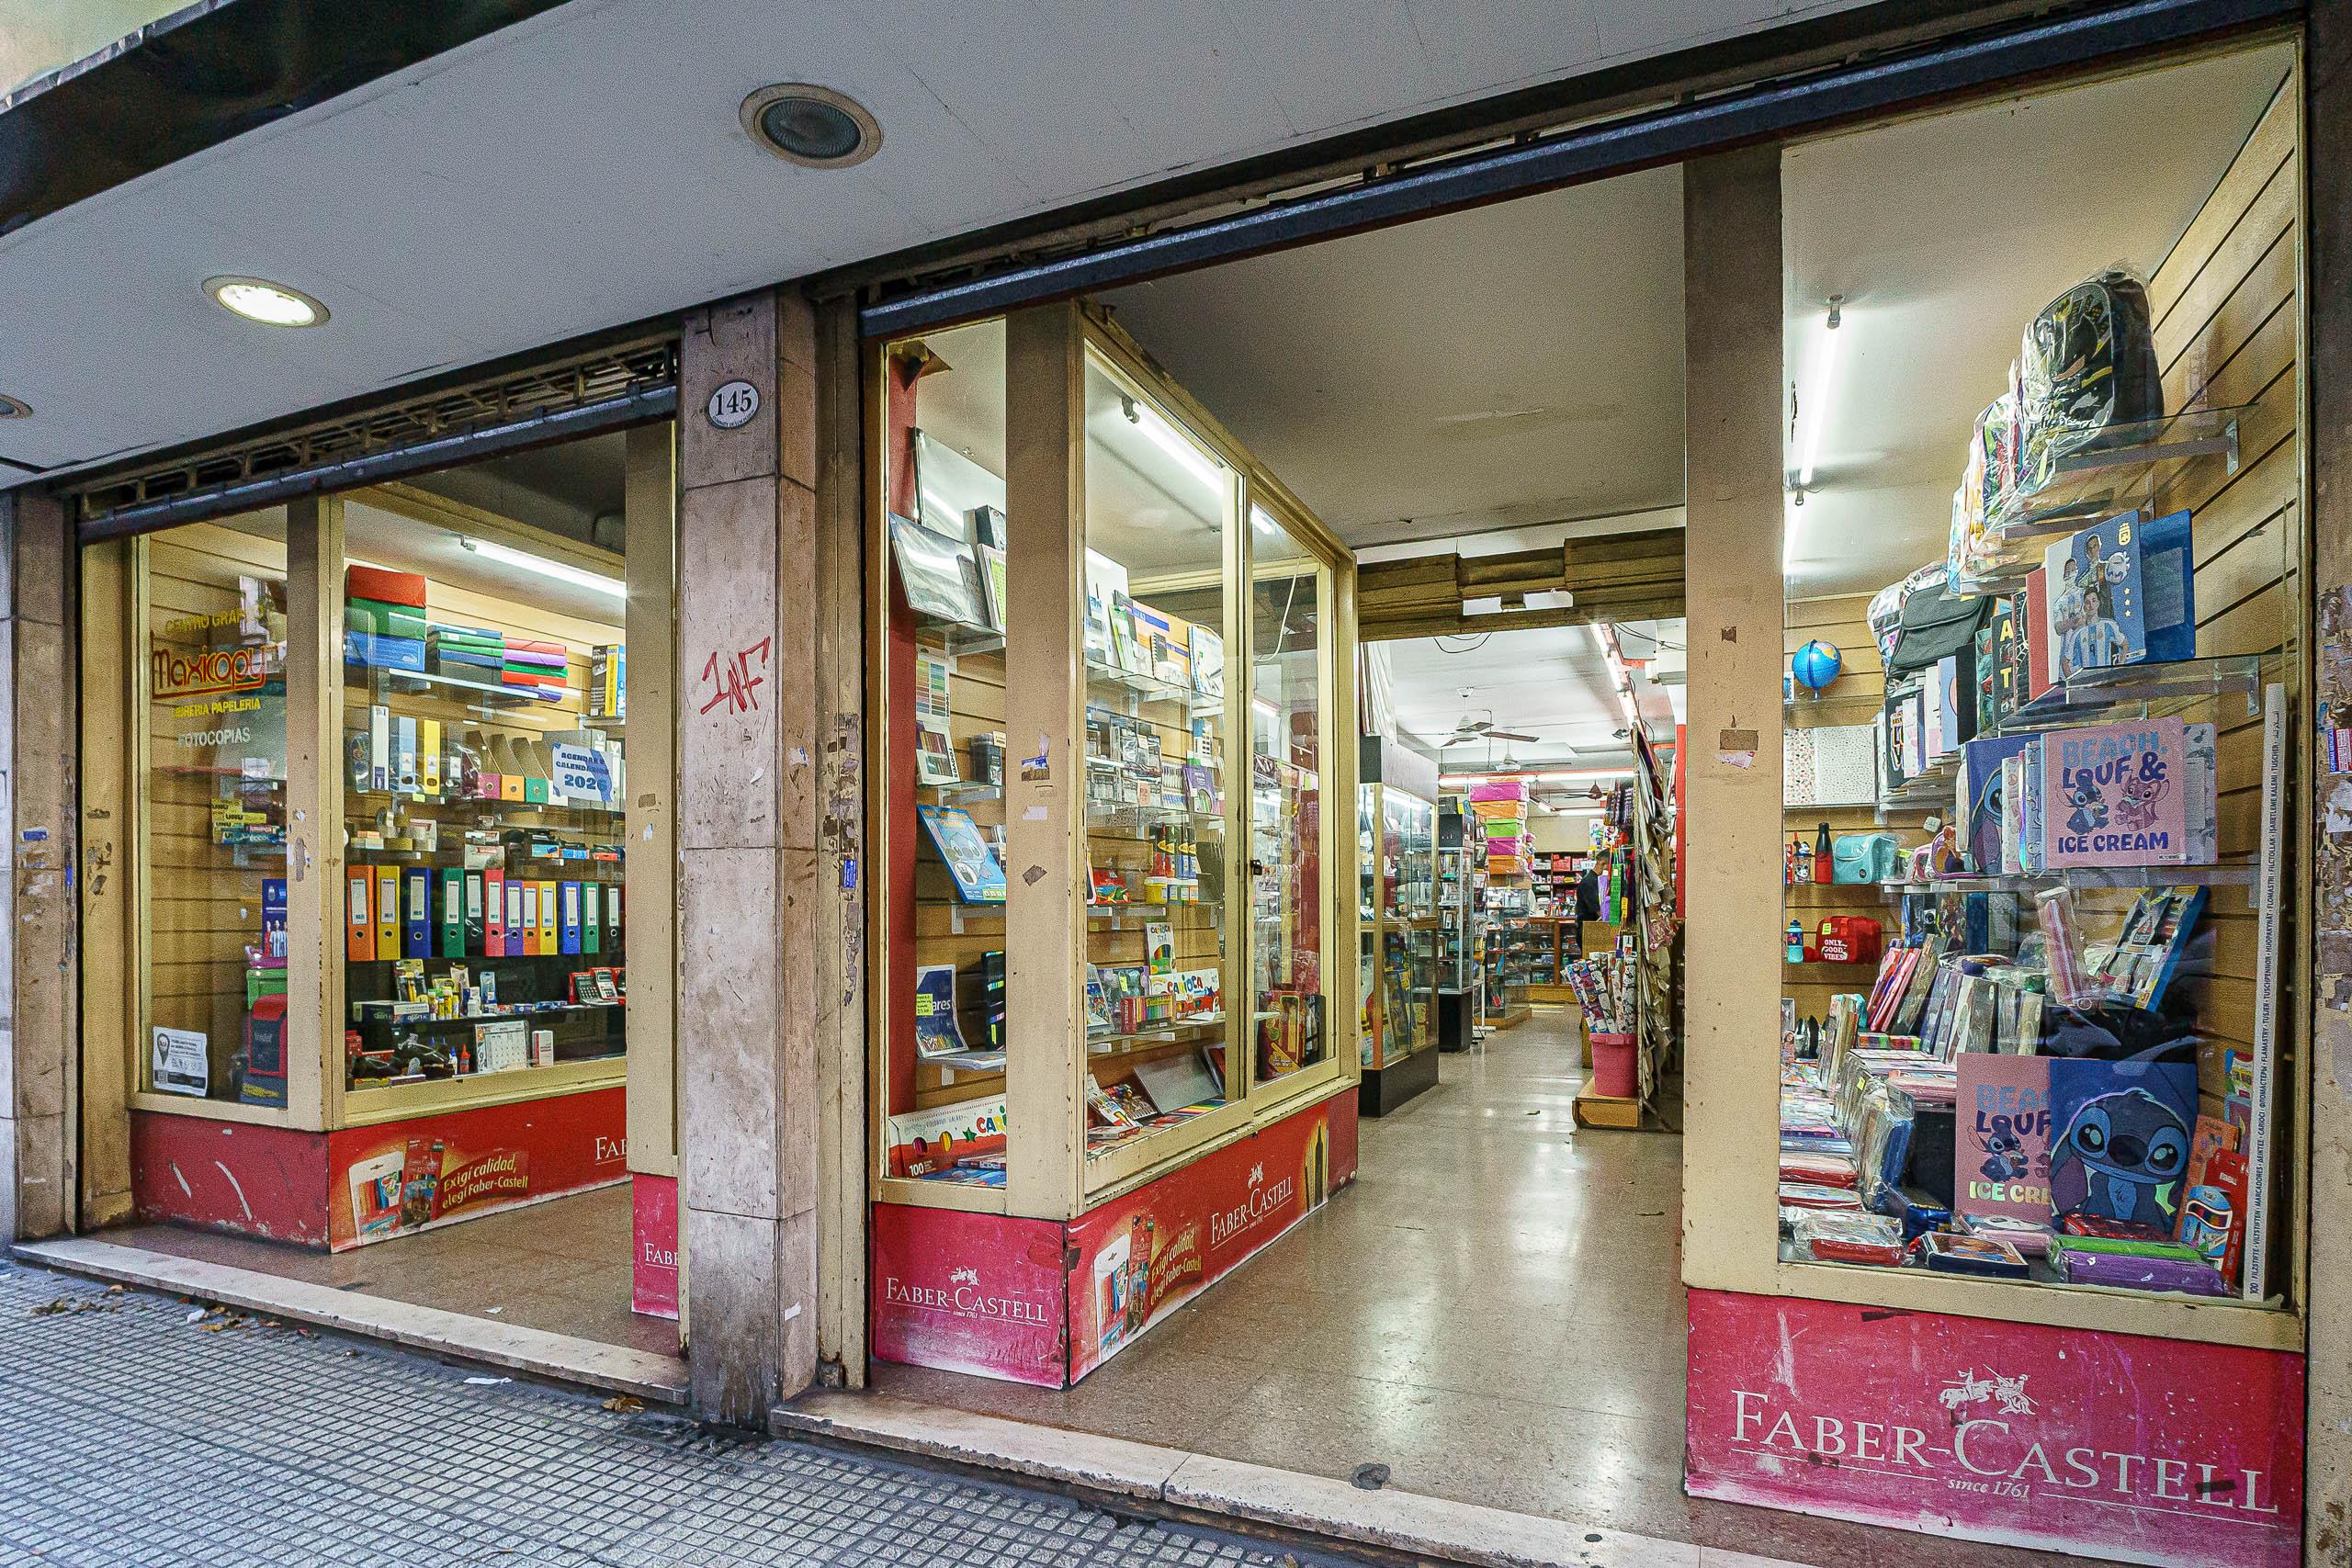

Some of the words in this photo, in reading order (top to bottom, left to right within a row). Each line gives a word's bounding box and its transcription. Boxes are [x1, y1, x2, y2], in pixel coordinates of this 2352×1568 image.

[716, 388, 752, 416] 145
[151, 642, 274, 695] Maxicopy
[211, 697, 261, 714] PAPELERIA
[176, 727, 251, 749] FOTOCOPIAS
[948, 747, 958, 778] reeves
[2139, 750, 2167, 782] &
[2058, 836, 2090, 854] ICE
[2093, 831, 2169, 852] CREAM
[2260, 1028, 2269, 1062] FLAMASTRY
[2267, 875, 2275, 908] FLOMASTRI
[2271, 745, 2279, 772] TUSCHER
[1150, 923, 1171, 935] CARIOCA
[1824, 939, 1843, 947] ONLY
[1824, 953, 1847, 961] VIBES
[1167, 974, 1204, 995] CARIOCA
[444, 1166, 472, 1192] Exigí
[473, 1154, 516, 1178] calidad,
[910, 1162, 924, 1177] 100
[442, 1189, 467, 1209] elegí
[468, 1175, 528, 1196] Faber-Castell
[1969, 1180, 2007, 1201] ICE
[1211, 1176, 1294, 1245] FABER-CASTELL
[2250, 1282, 2259, 1294] 100
[2255, 1167, 2264, 1207] MARCADORES
[1165, 1254, 1202, 1286] Faber-Castell
[886, 1277, 1049, 1323] FABER-CASTELL
[1730, 1389, 2279, 1514] FABER-CASTELL
[1947, 1477, 1988, 1494] since
[1992, 1480, 2030, 1499] 1761
